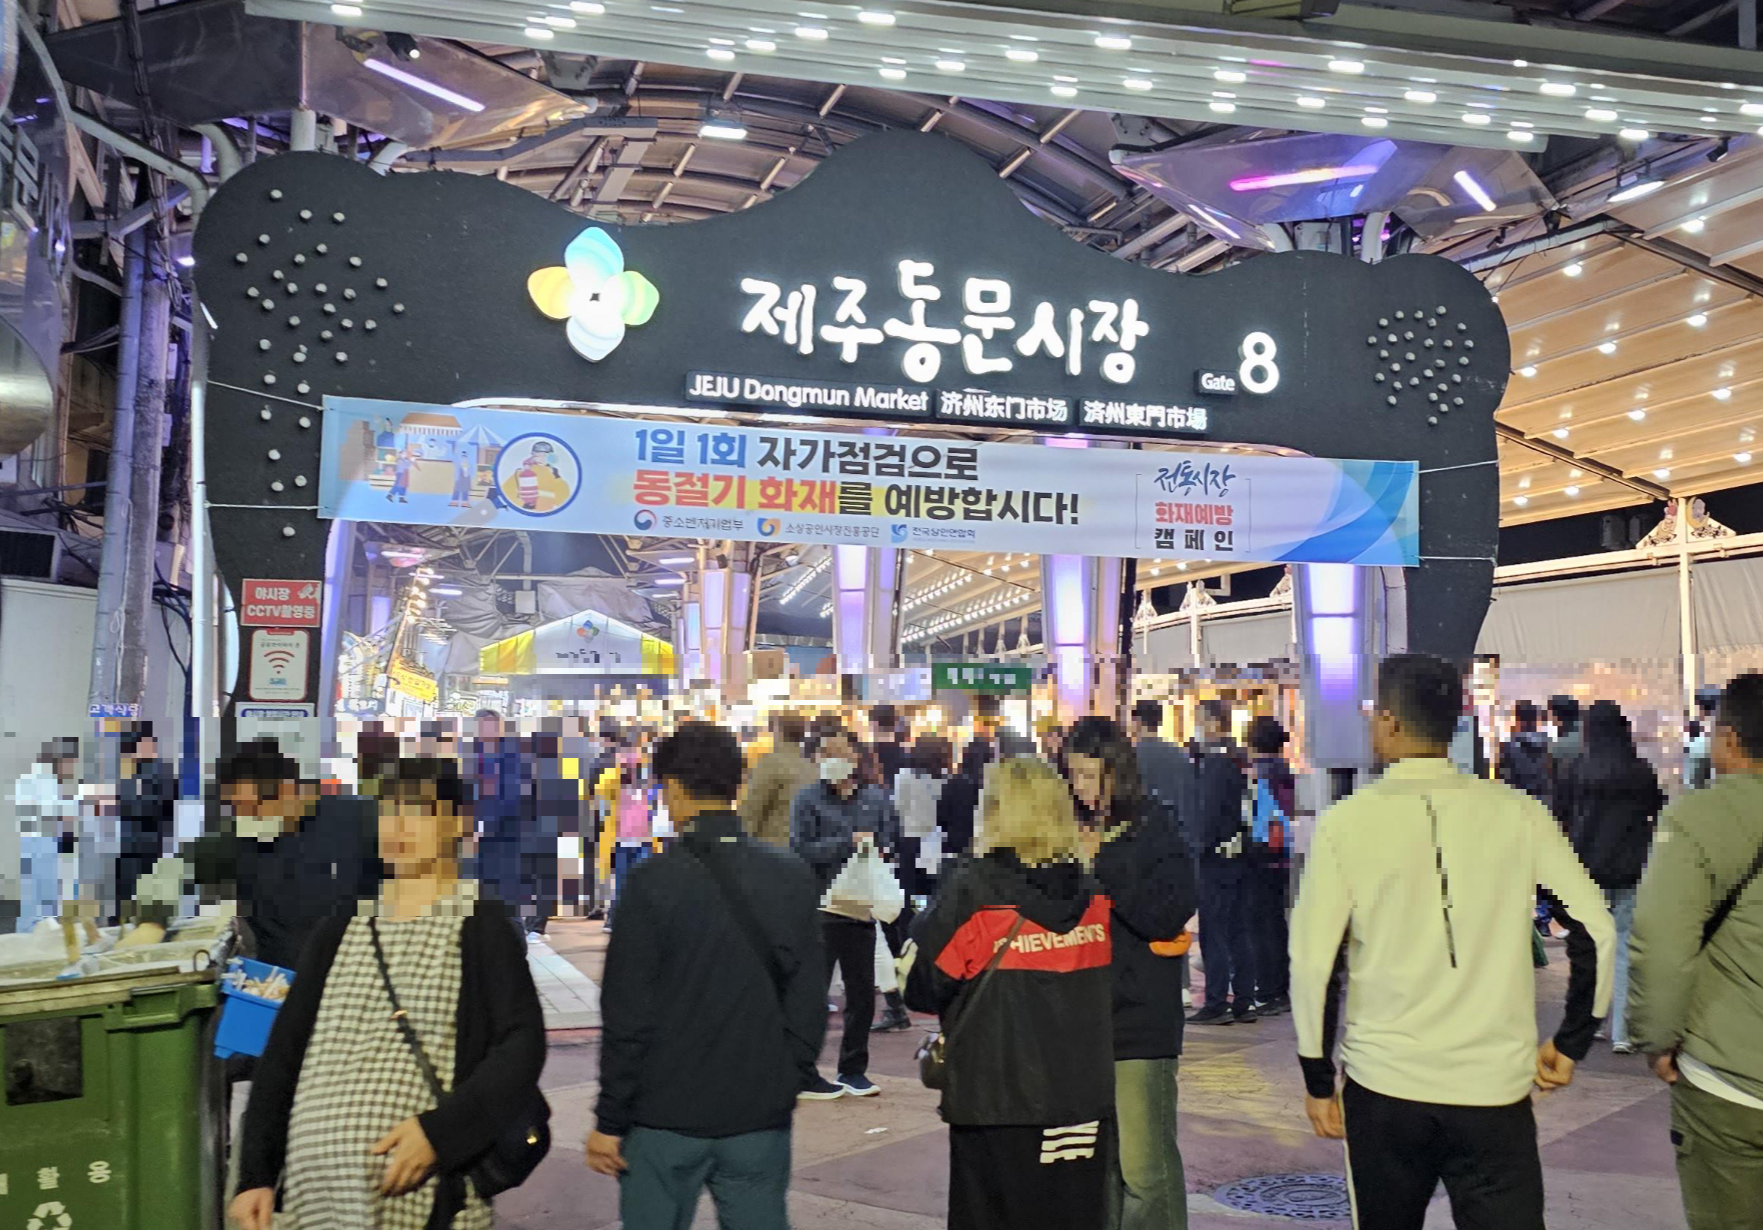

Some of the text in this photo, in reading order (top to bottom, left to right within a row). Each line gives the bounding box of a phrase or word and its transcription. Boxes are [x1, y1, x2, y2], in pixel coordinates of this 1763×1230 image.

[740, 259, 1150, 384] 제주동문시장
[1201, 331, 1280, 394] Gate 8
[689, 374, 930, 411] JEJU Dongmun Market
[940, 390, 1068, 422] 济州东门市场
[634, 427, 978, 481] 1일 1회 자가점검으로
[633, 468, 1080, 525] 동절기 화재를 예방합시다!
[1154, 459, 1237, 498] 전통시장
[785, 523, 880, 539] 소상공인시장진흥공단
[1155, 501, 1234, 526] 화재예방
[246, 604, 316, 619] CCTV촬영중
[255, 587, 291, 601] 야시장
